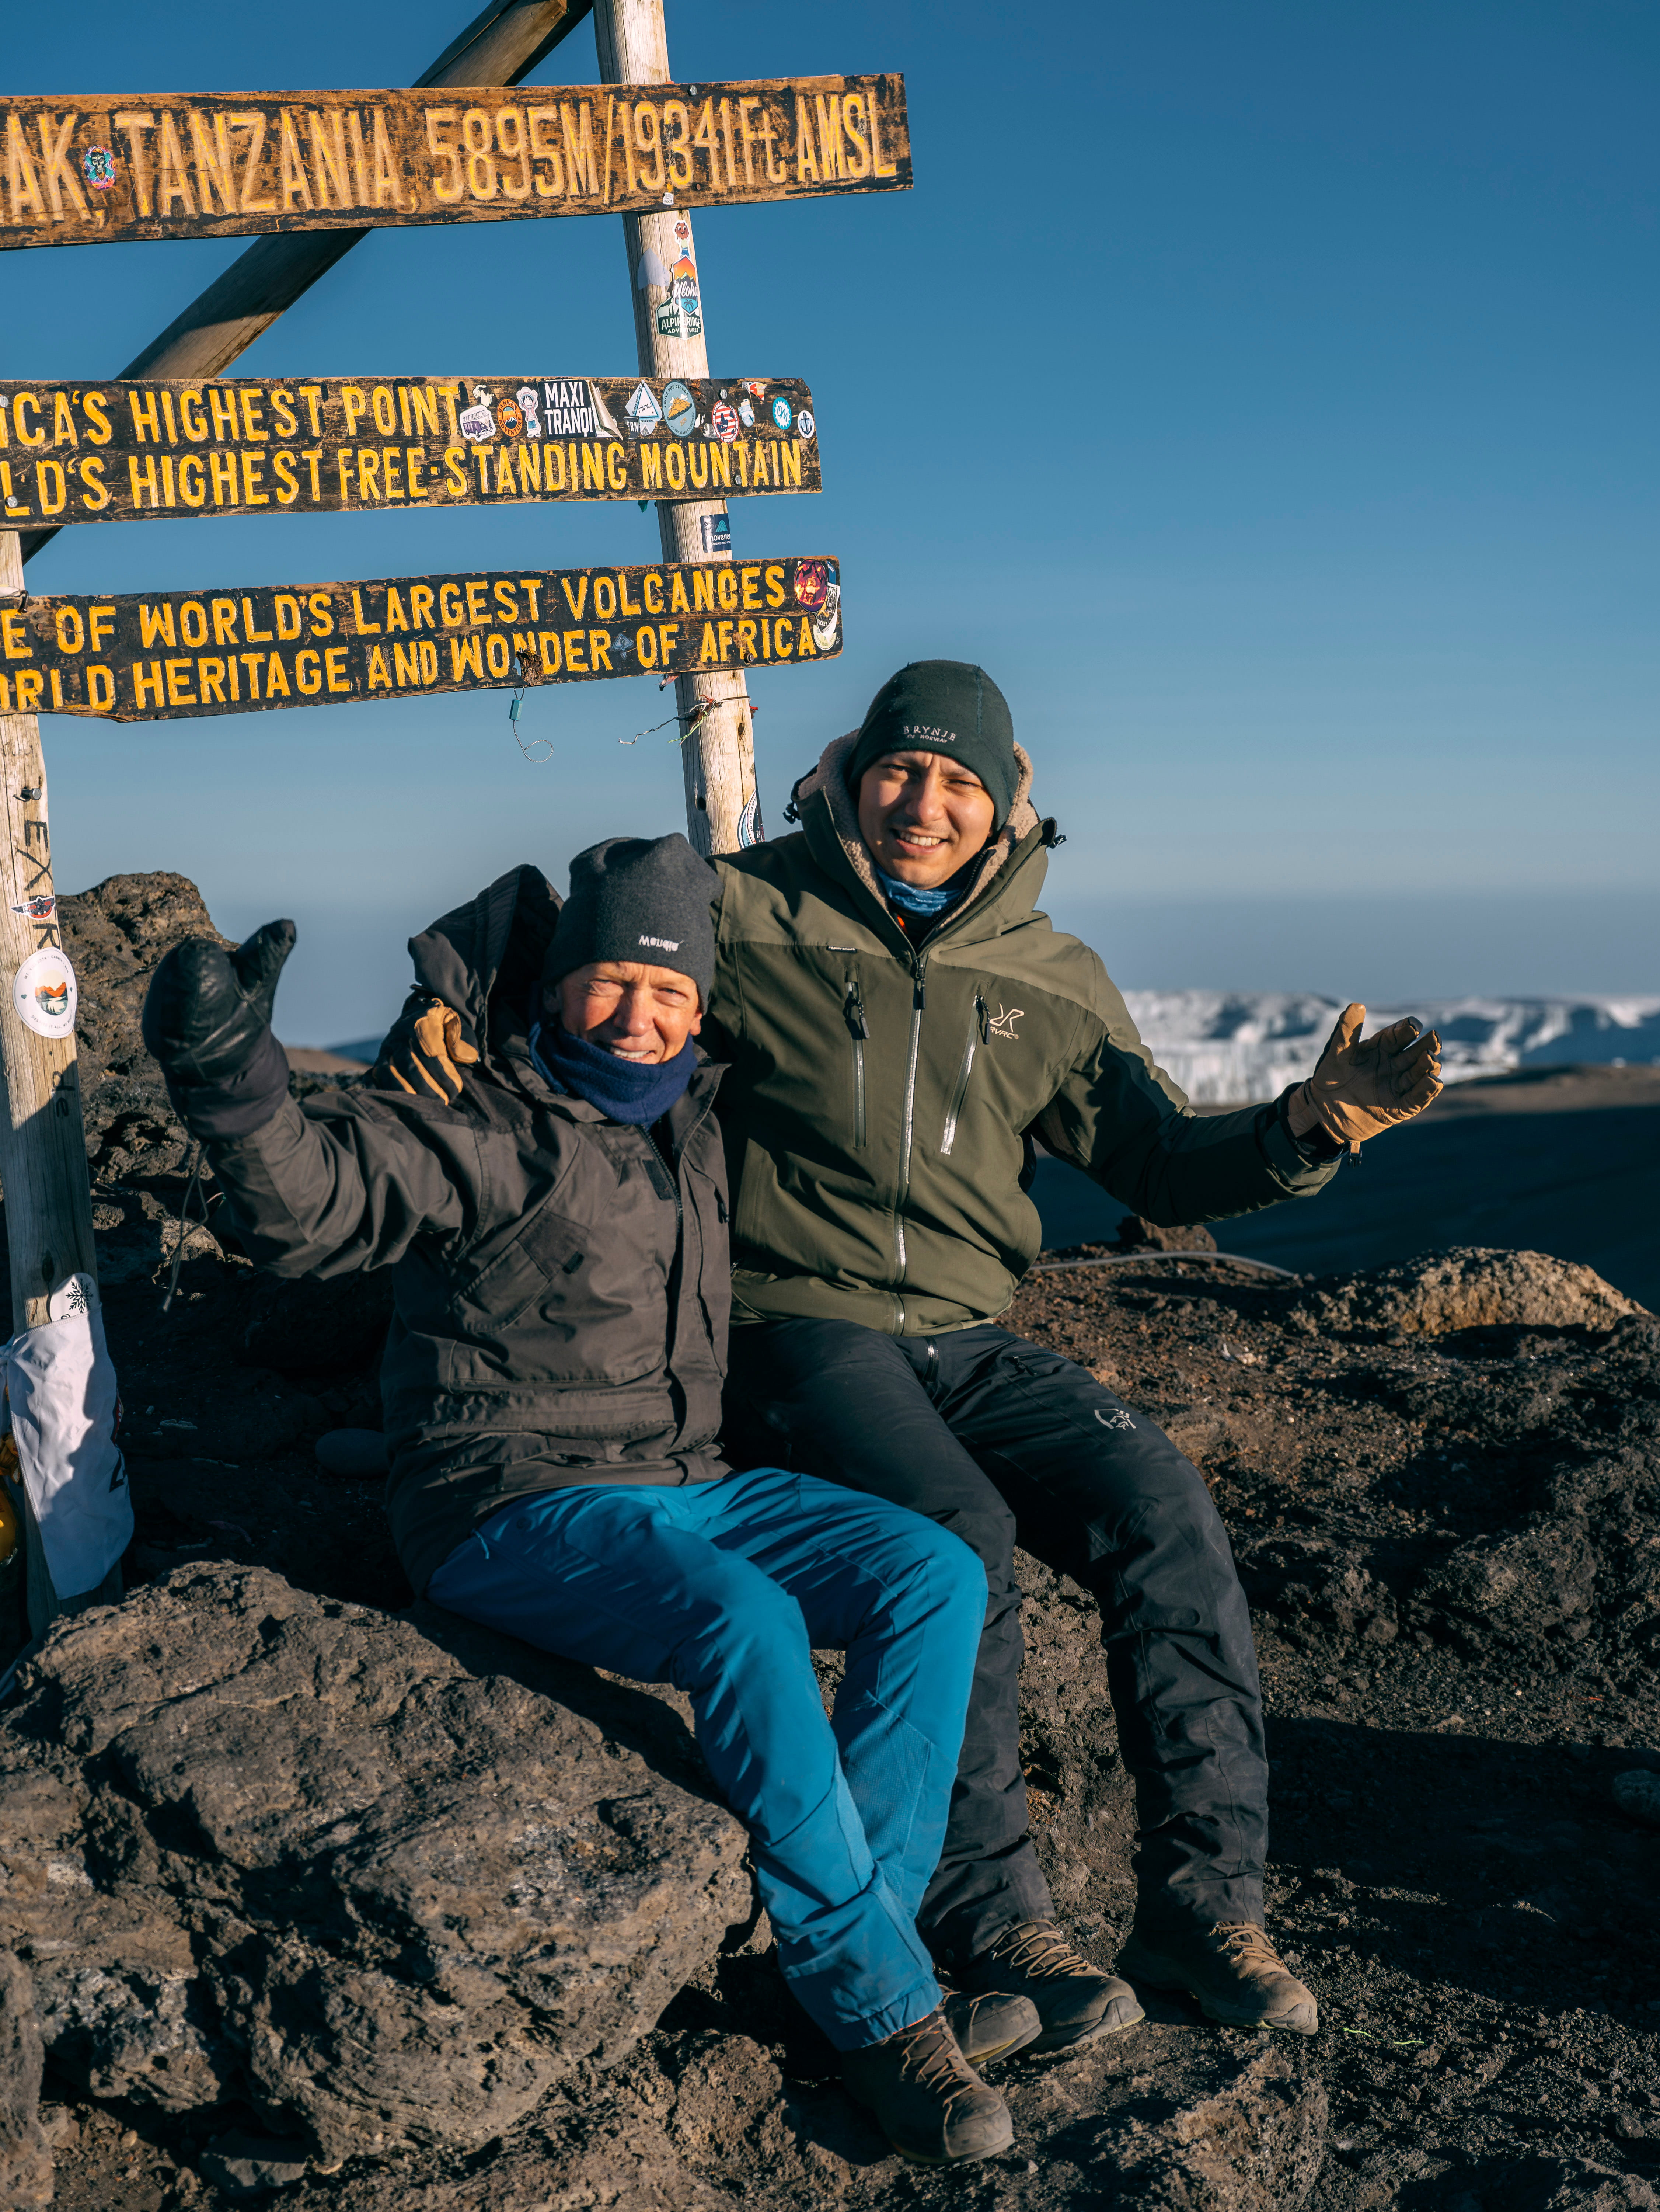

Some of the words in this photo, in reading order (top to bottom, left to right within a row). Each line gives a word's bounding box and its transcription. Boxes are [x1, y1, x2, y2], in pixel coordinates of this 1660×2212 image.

[0, 115, 105, 229] AK,
[797, 91, 897, 182] AMSL
[687, 315, 701, 328] RIDGE
[544, 382, 584, 408] MAXI
[675, 385, 688, 396] CLOUDS
[129, 386, 322, 443] HIGHEST
[341, 385, 459, 437] POINT
[498, 400, 517, 413] BANKER
[638, 402, 652, 413] ninu
[499, 417, 522, 435] ADVENTURE
[128, 449, 322, 509] HIGHEST
[640, 439, 801, 490] MOUNTAIN
[55, 605, 116, 654] OF
[139, 593, 334, 648] WORLD'S
[352, 579, 542, 635] LARGEST
[561, 565, 785, 621] VOLCANOES
[133, 646, 351, 709] HERITAGE
[368, 641, 438, 689] AND
[636, 624, 679, 668] OF
[701, 616, 817, 662] AFRICA
[920, 734, 948, 744] NORWAY
